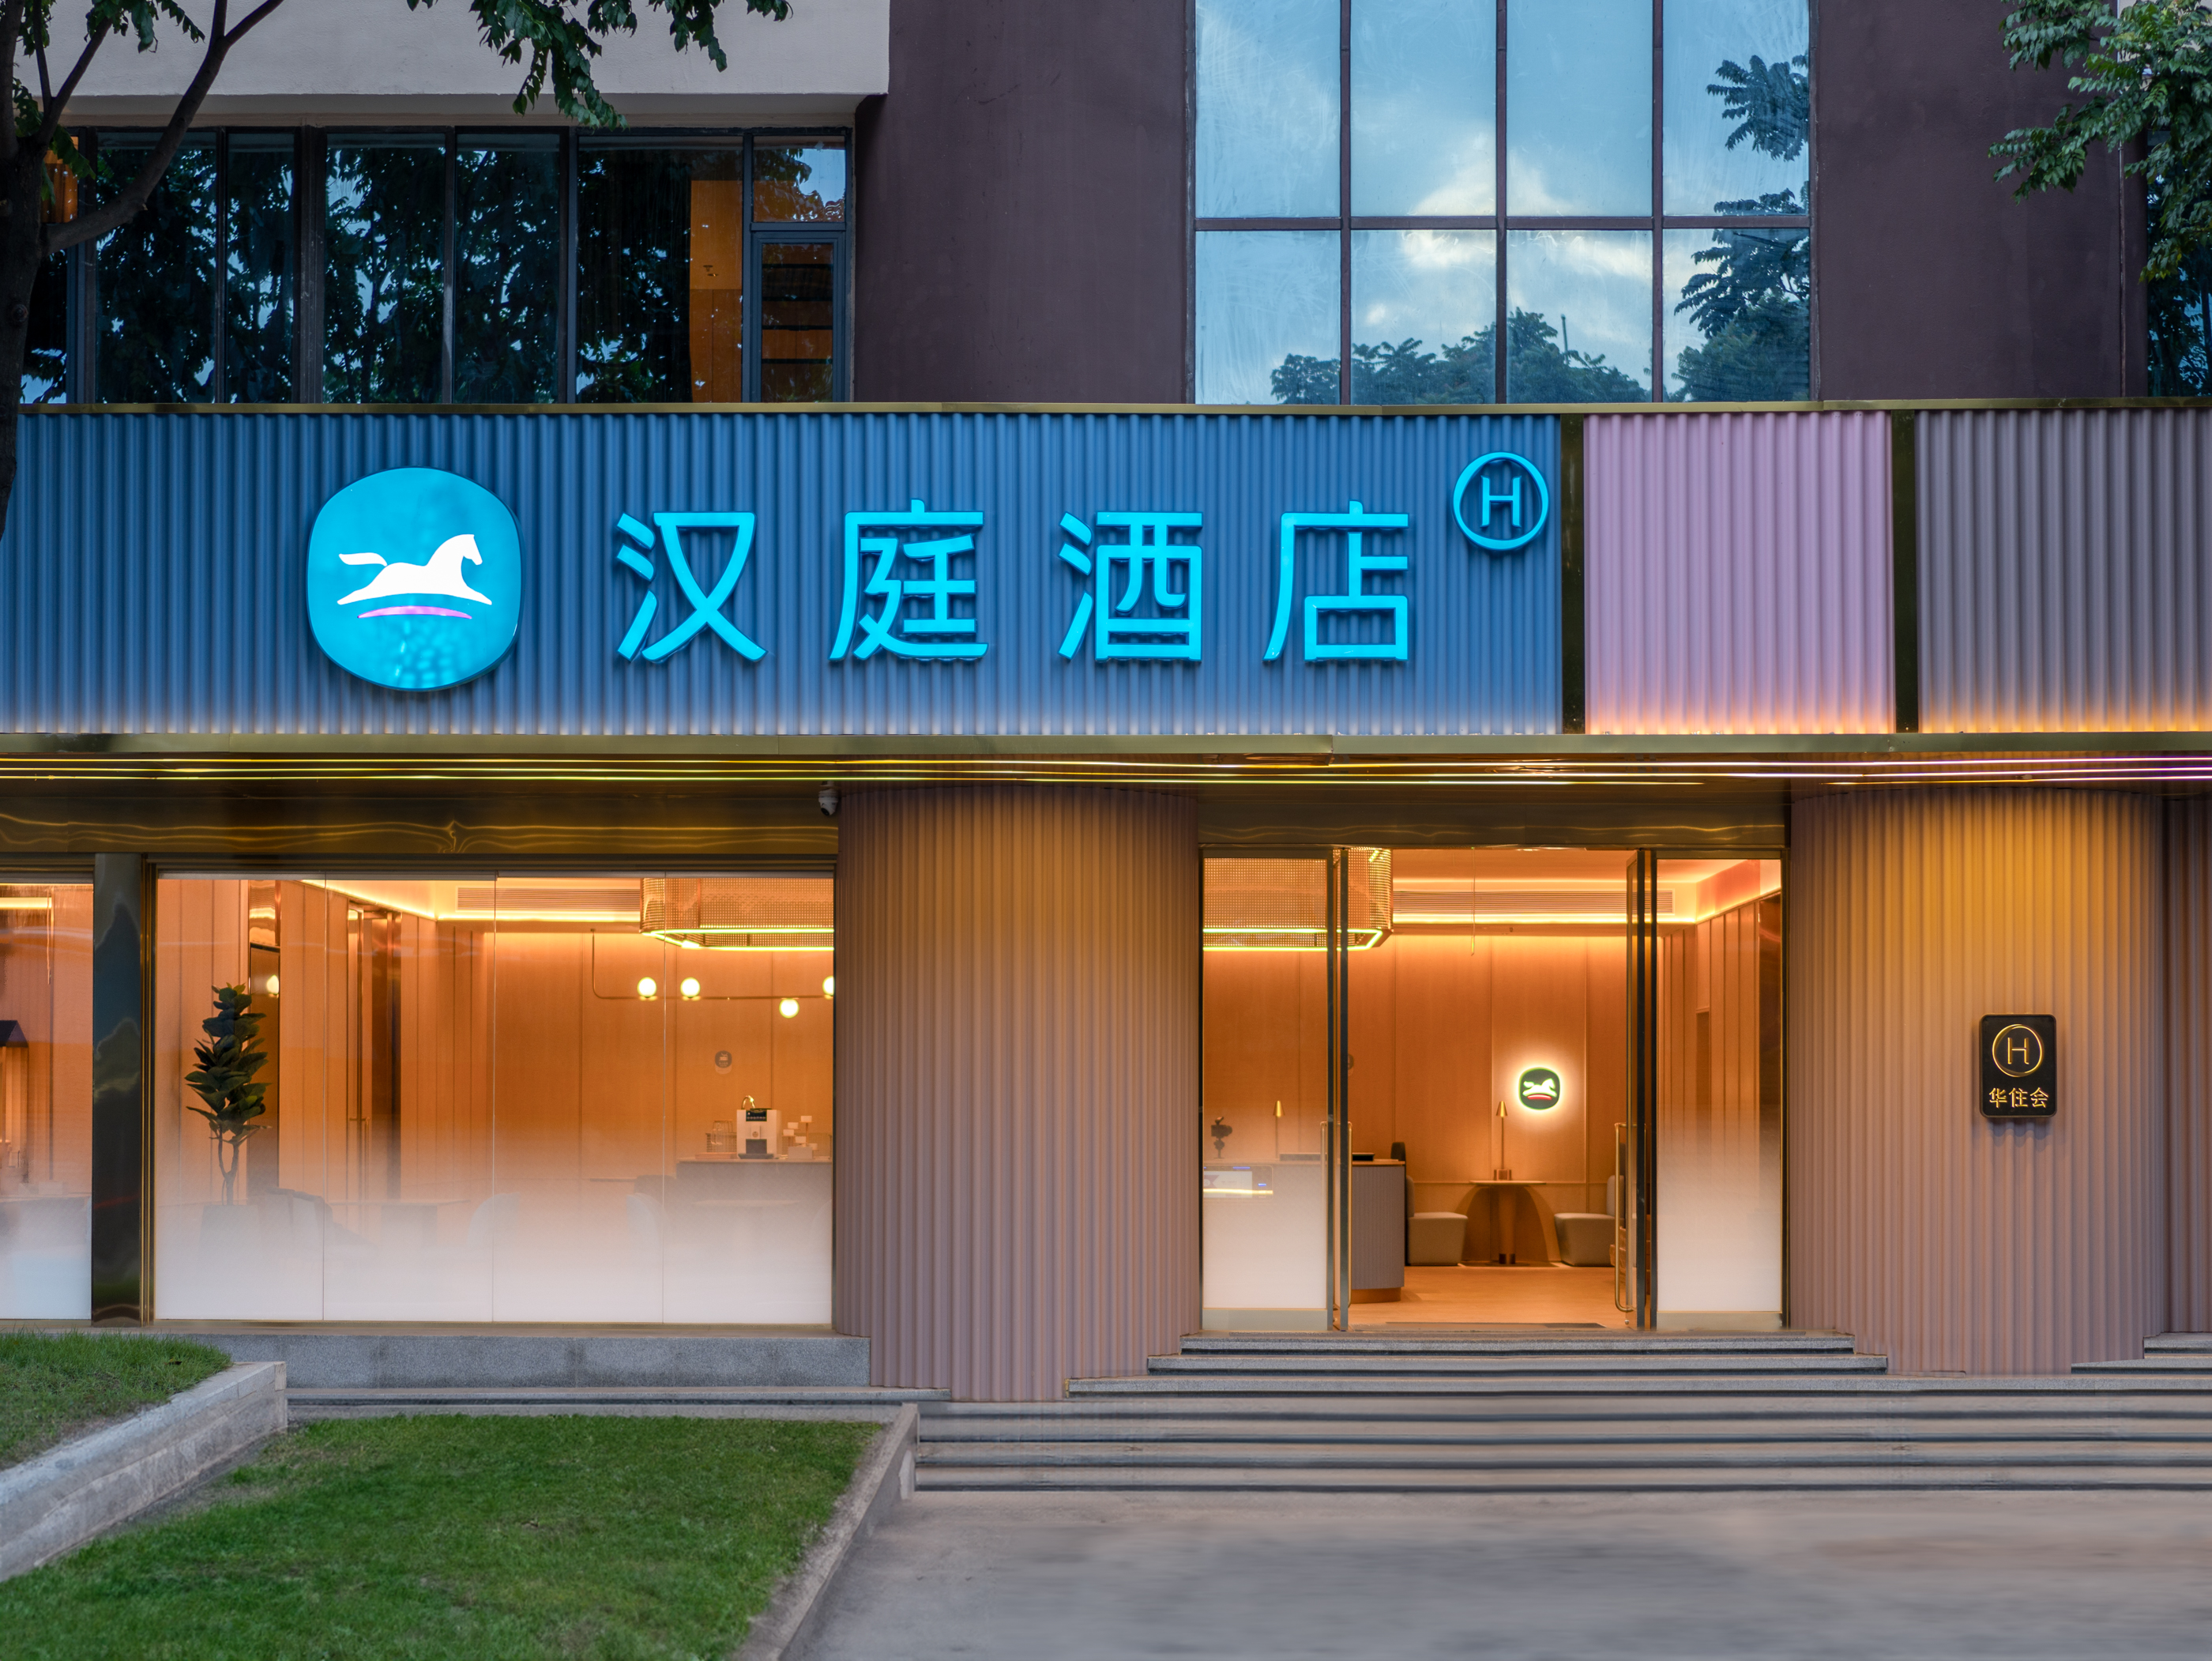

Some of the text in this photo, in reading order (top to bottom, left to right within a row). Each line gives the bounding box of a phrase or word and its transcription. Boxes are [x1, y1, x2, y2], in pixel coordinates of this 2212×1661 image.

[1480, 476, 1522, 528] H
[616, 498, 1409, 661] 汉庭酒店
[2007, 1037, 2030, 1064] H
[1988, 1087, 2049, 1108] 华住会
